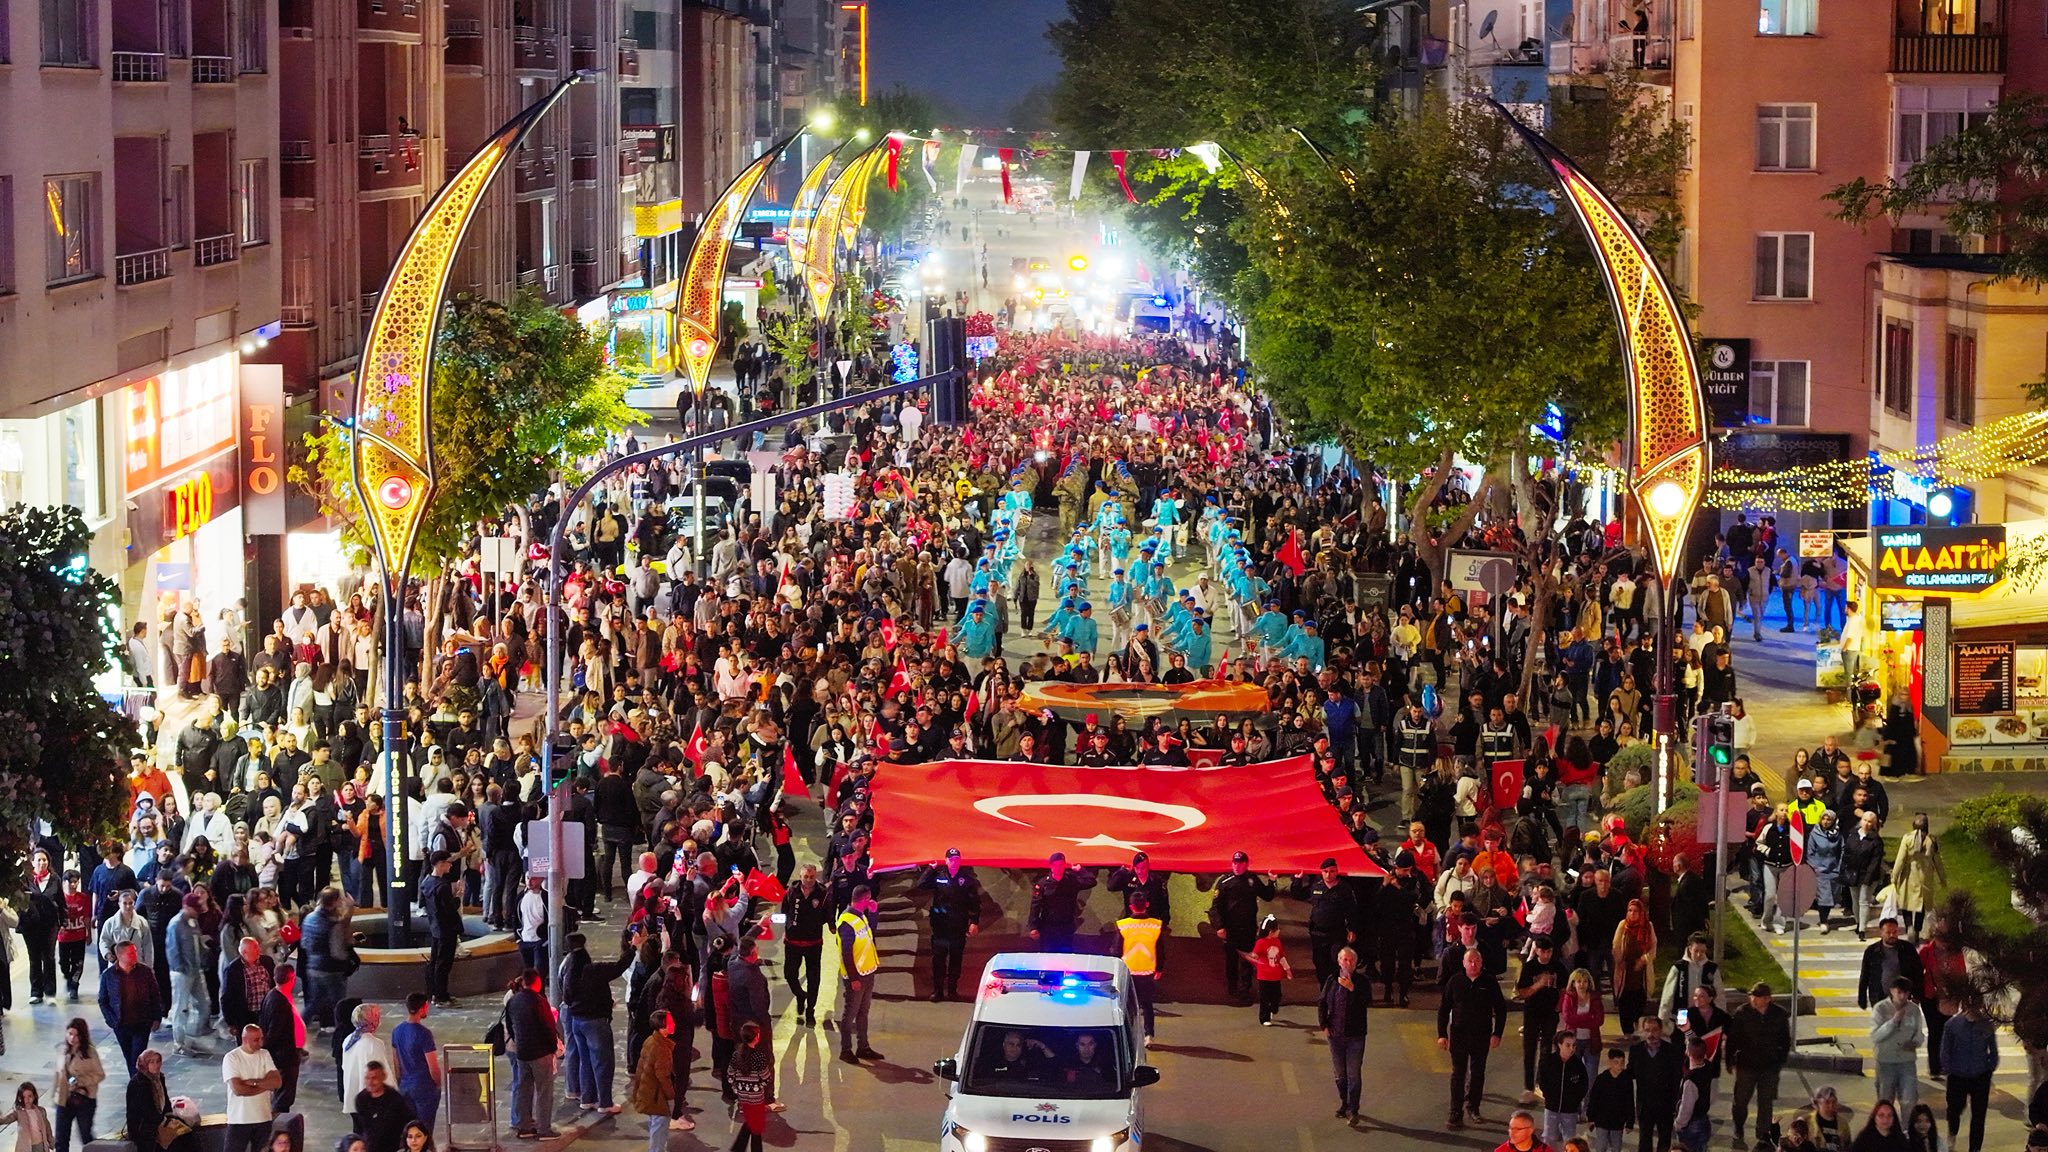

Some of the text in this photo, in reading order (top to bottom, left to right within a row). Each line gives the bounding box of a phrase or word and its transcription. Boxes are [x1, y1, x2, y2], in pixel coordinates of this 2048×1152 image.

[1708, 383, 1738, 394] YİĞİT
[249, 404, 278, 495] FLO
[175, 470, 212, 540] FLO
[1881, 533, 1921, 547] TARİHİ
[1880, 538, 2006, 578] ALAATTİN
[1906, 573, 1925, 585] PİDE
[1926, 573, 1971, 585] LAHMACUN
[1012, 1114, 1071, 1124] POLİS
